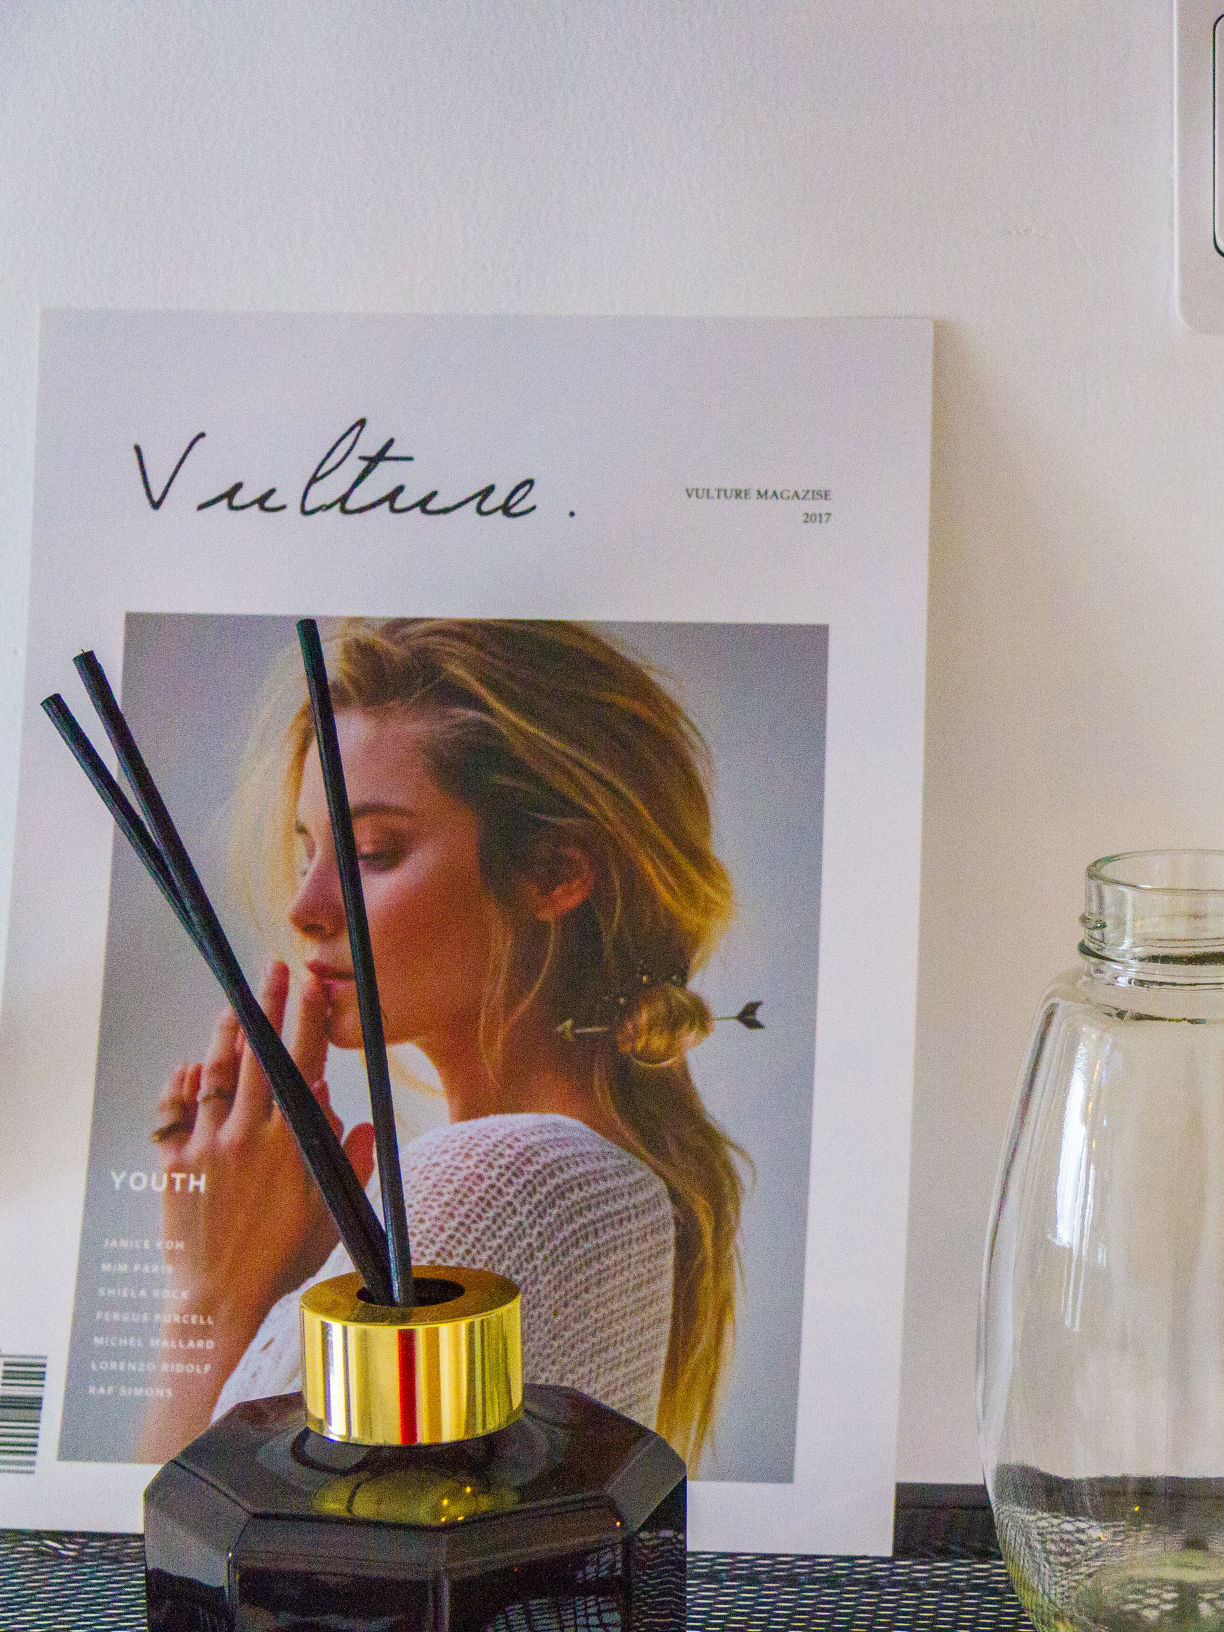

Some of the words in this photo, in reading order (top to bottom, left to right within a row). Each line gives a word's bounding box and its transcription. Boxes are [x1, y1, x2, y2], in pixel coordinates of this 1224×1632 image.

[685, 487, 751, 500] VULTURE
[802, 511, 832, 524] 2017
[110, 1171, 207, 1194] YOUTH
[153, 1312, 215, 1325] PURCELL
[93, 1335, 143, 1347] MICHEL
